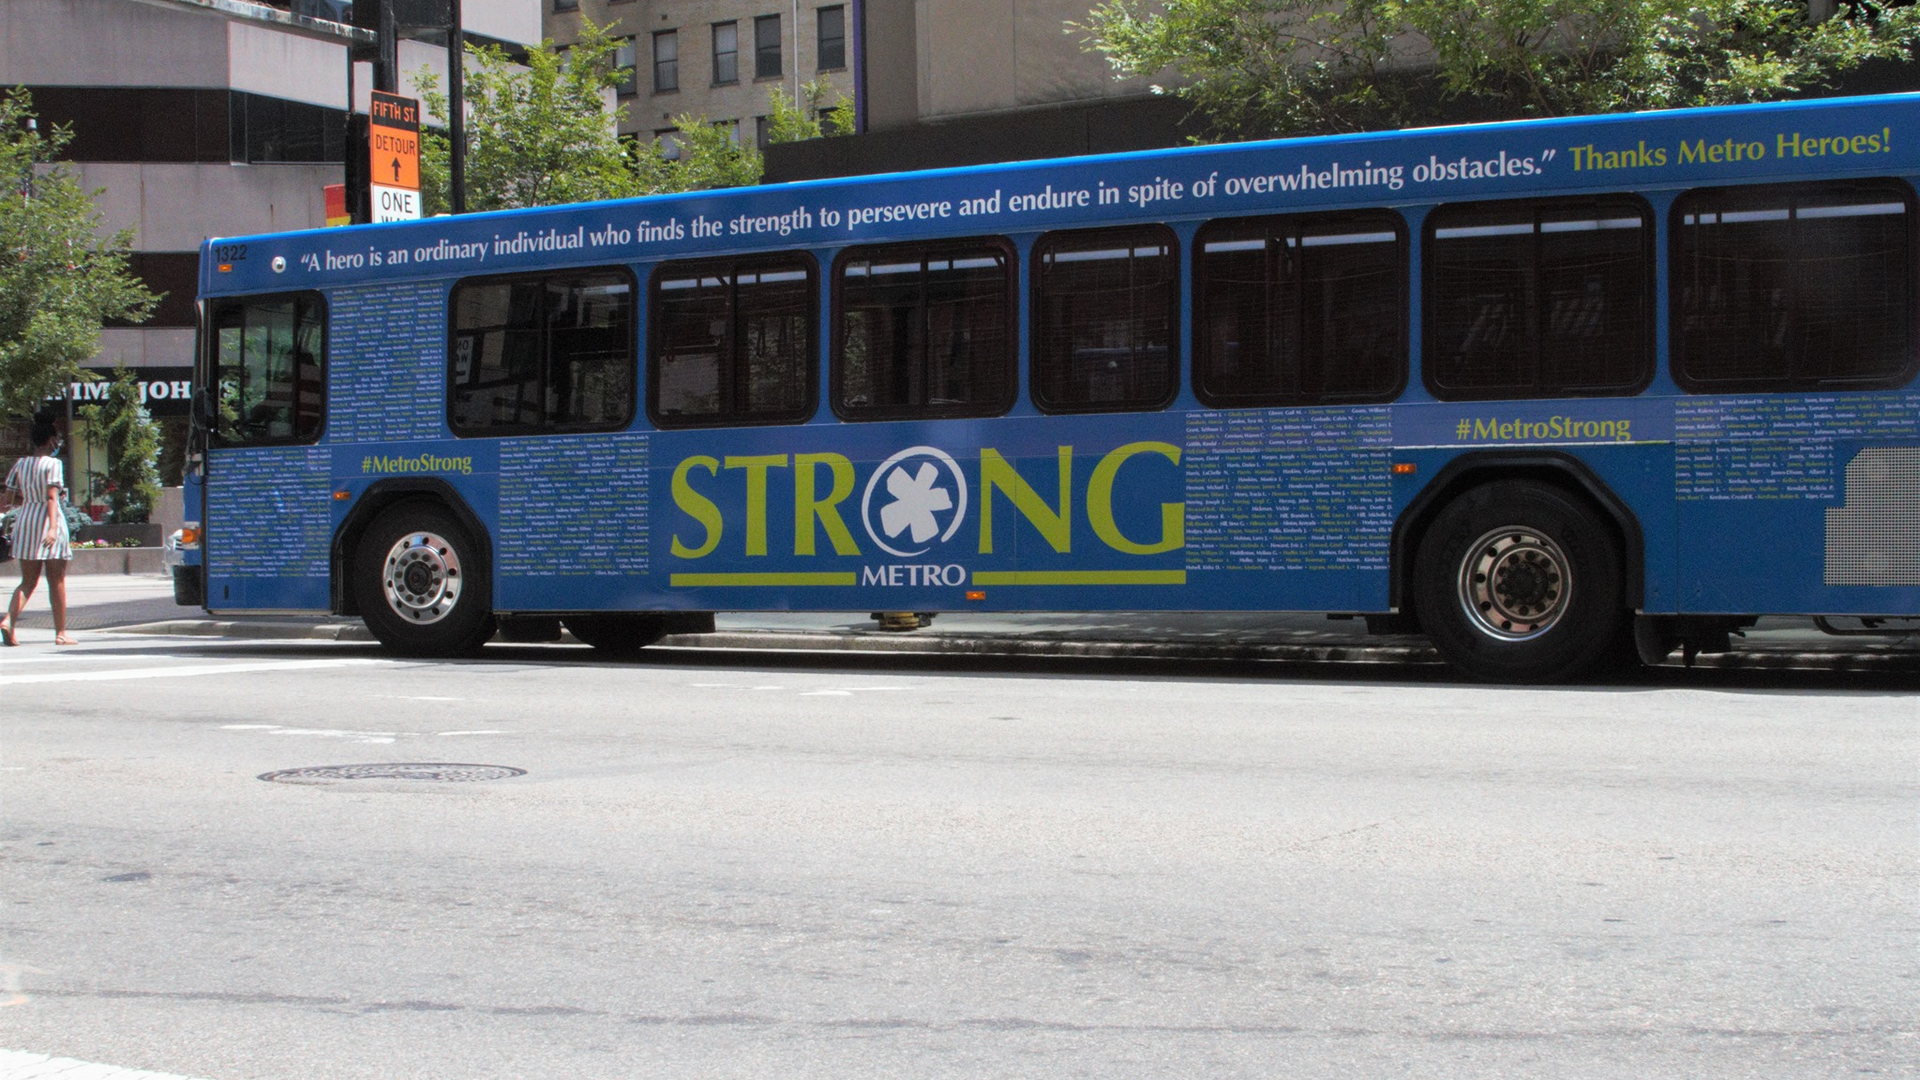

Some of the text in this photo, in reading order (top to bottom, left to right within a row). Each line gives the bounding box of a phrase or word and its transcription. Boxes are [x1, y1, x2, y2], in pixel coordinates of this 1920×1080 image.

[373, 100, 417, 123] FIFTH ST.
[375, 134, 416, 156] DETOUR
[326, 250, 364, 270] hero
[369, 246, 382, 266] is
[387, 249, 408, 265] an
[414, 239, 486, 267] ordinary
[494, 226, 584, 256] individual
[589, 223, 631, 246] who
[637, 217, 684, 243] finds
[691, 215, 723, 238] the
[730, 206, 812, 236] strength
[819, 207, 841, 227] to
[848, 201, 951, 231] persevere
[958, 189, 1001, 216] and
[1008, 185, 1090, 212] endure
[1099, 181, 1120, 205] in
[1128, 176, 1184, 208] spite
[1192, 171, 1218, 197] of
[1225, 160, 1404, 196] overwhelming
[1569, 140, 1667, 171] Thanks
[1678, 139, 1765, 165] Metro
[1777, 127, 1890, 159] Heroes!
[381, 190, 413, 213] ONE
[214, 244, 248, 263] 1322
[1456, 416, 1632, 442] #MetroStrong
[361, 455, 473, 476] #MetroStrong
[862, 564, 967, 587] METRO
